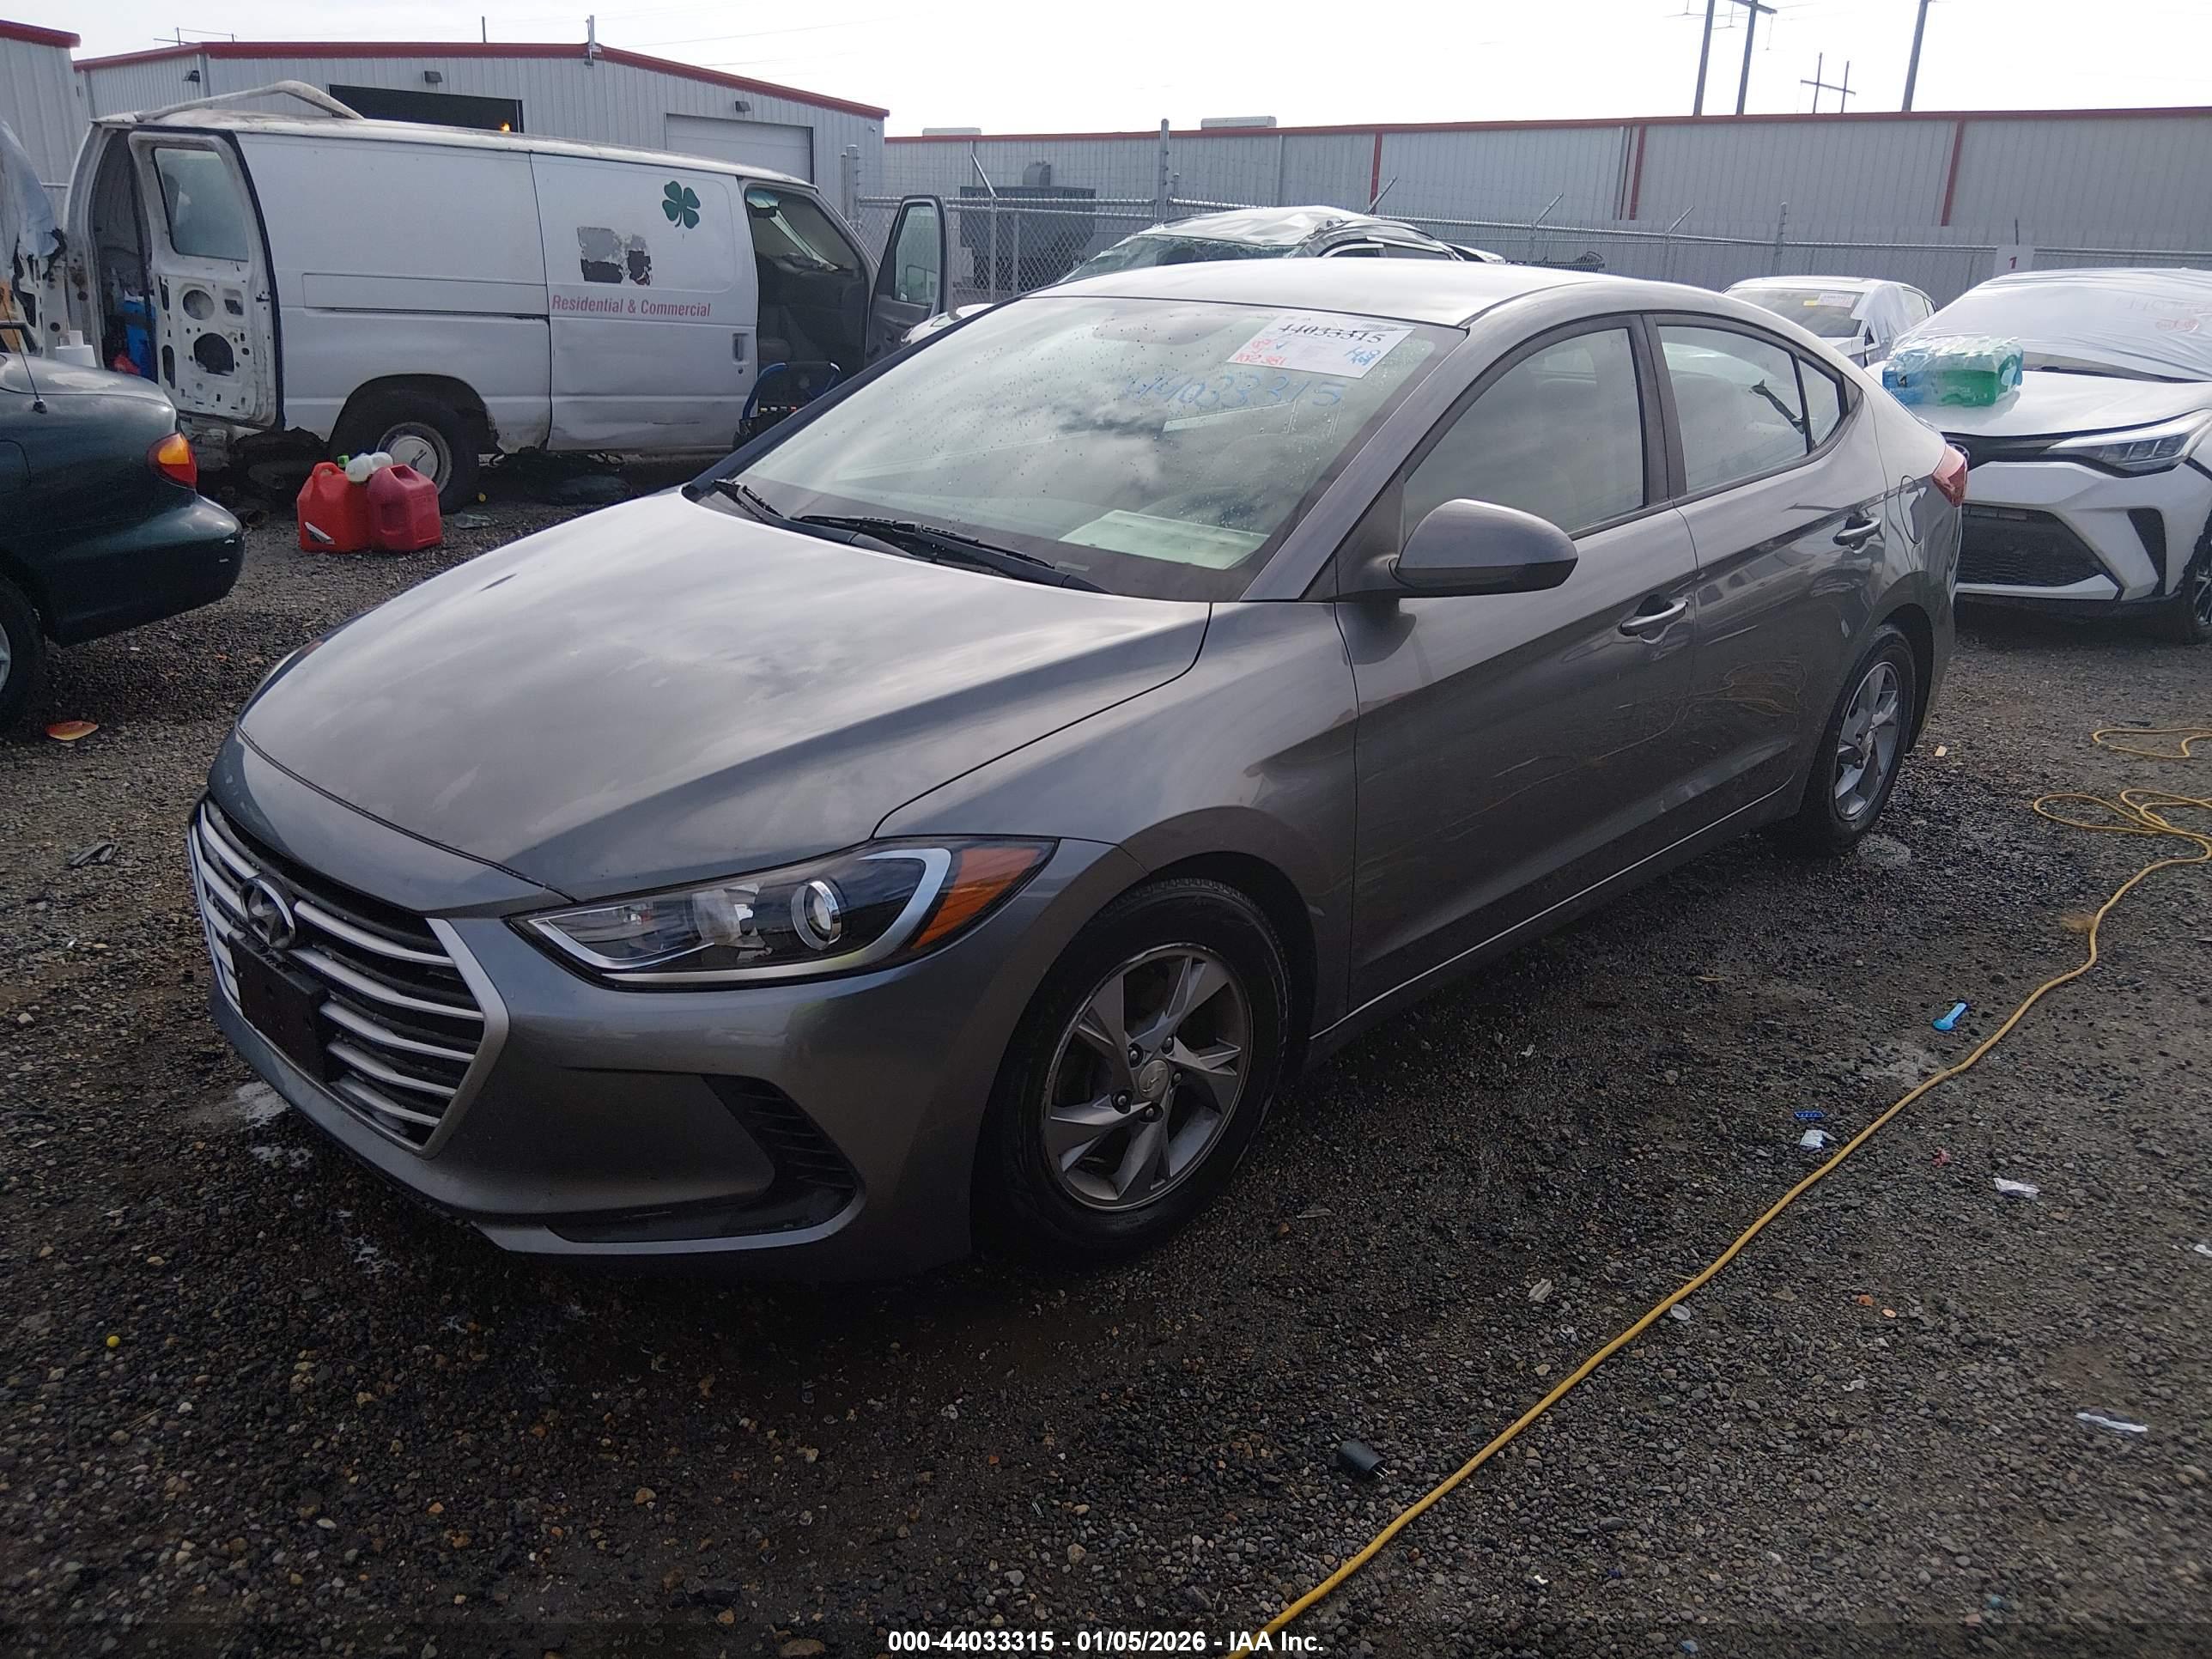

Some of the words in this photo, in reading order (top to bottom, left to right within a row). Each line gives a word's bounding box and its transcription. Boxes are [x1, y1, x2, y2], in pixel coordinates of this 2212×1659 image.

[2008, 255, 2018, 270] 1
[551, 295, 624, 313] Residential
[628, 301, 636, 313] &
[641, 300, 711, 317] Commercial
